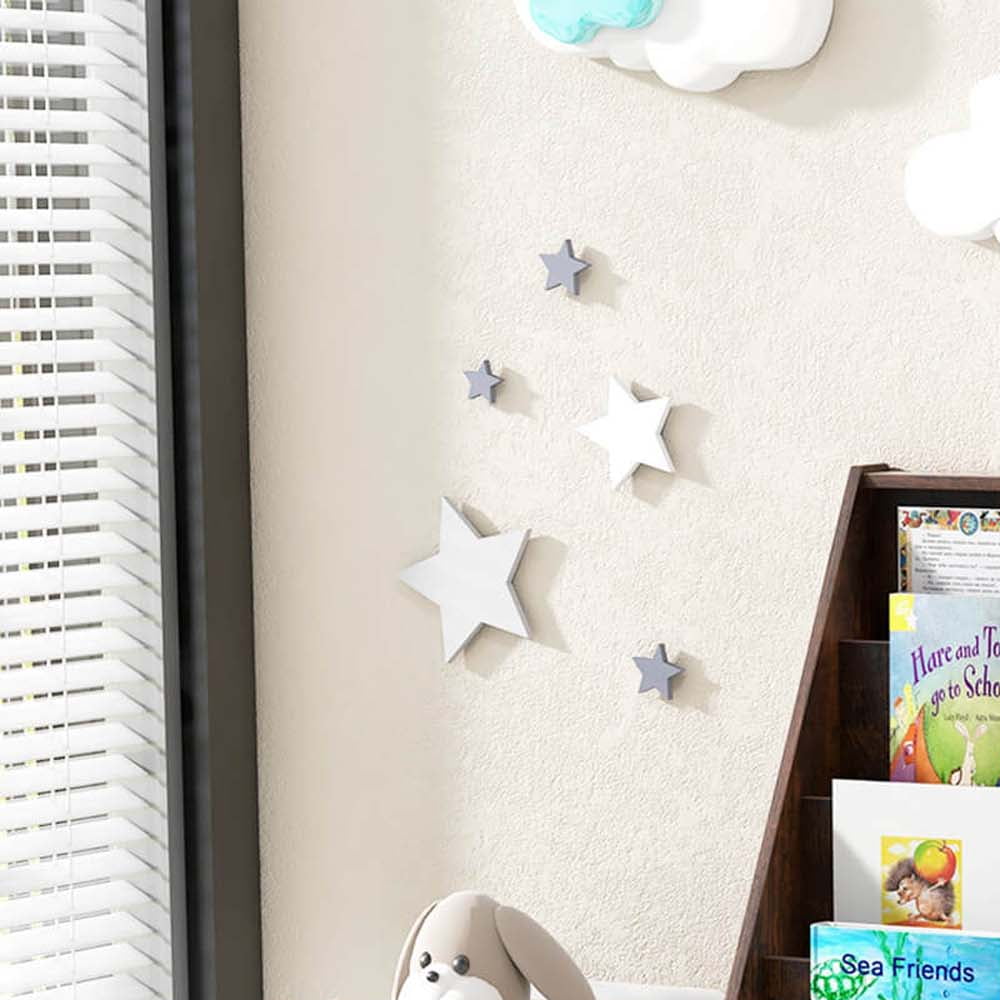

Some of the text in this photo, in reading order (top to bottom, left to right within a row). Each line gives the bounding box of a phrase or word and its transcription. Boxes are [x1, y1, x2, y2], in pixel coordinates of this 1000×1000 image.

[910, 645, 952, 685] Hare
[956, 636, 979, 660] and
[931, 689, 946, 717] go
[948, 680, 961, 700] to
[840, 954, 975, 984] Sea Friends
